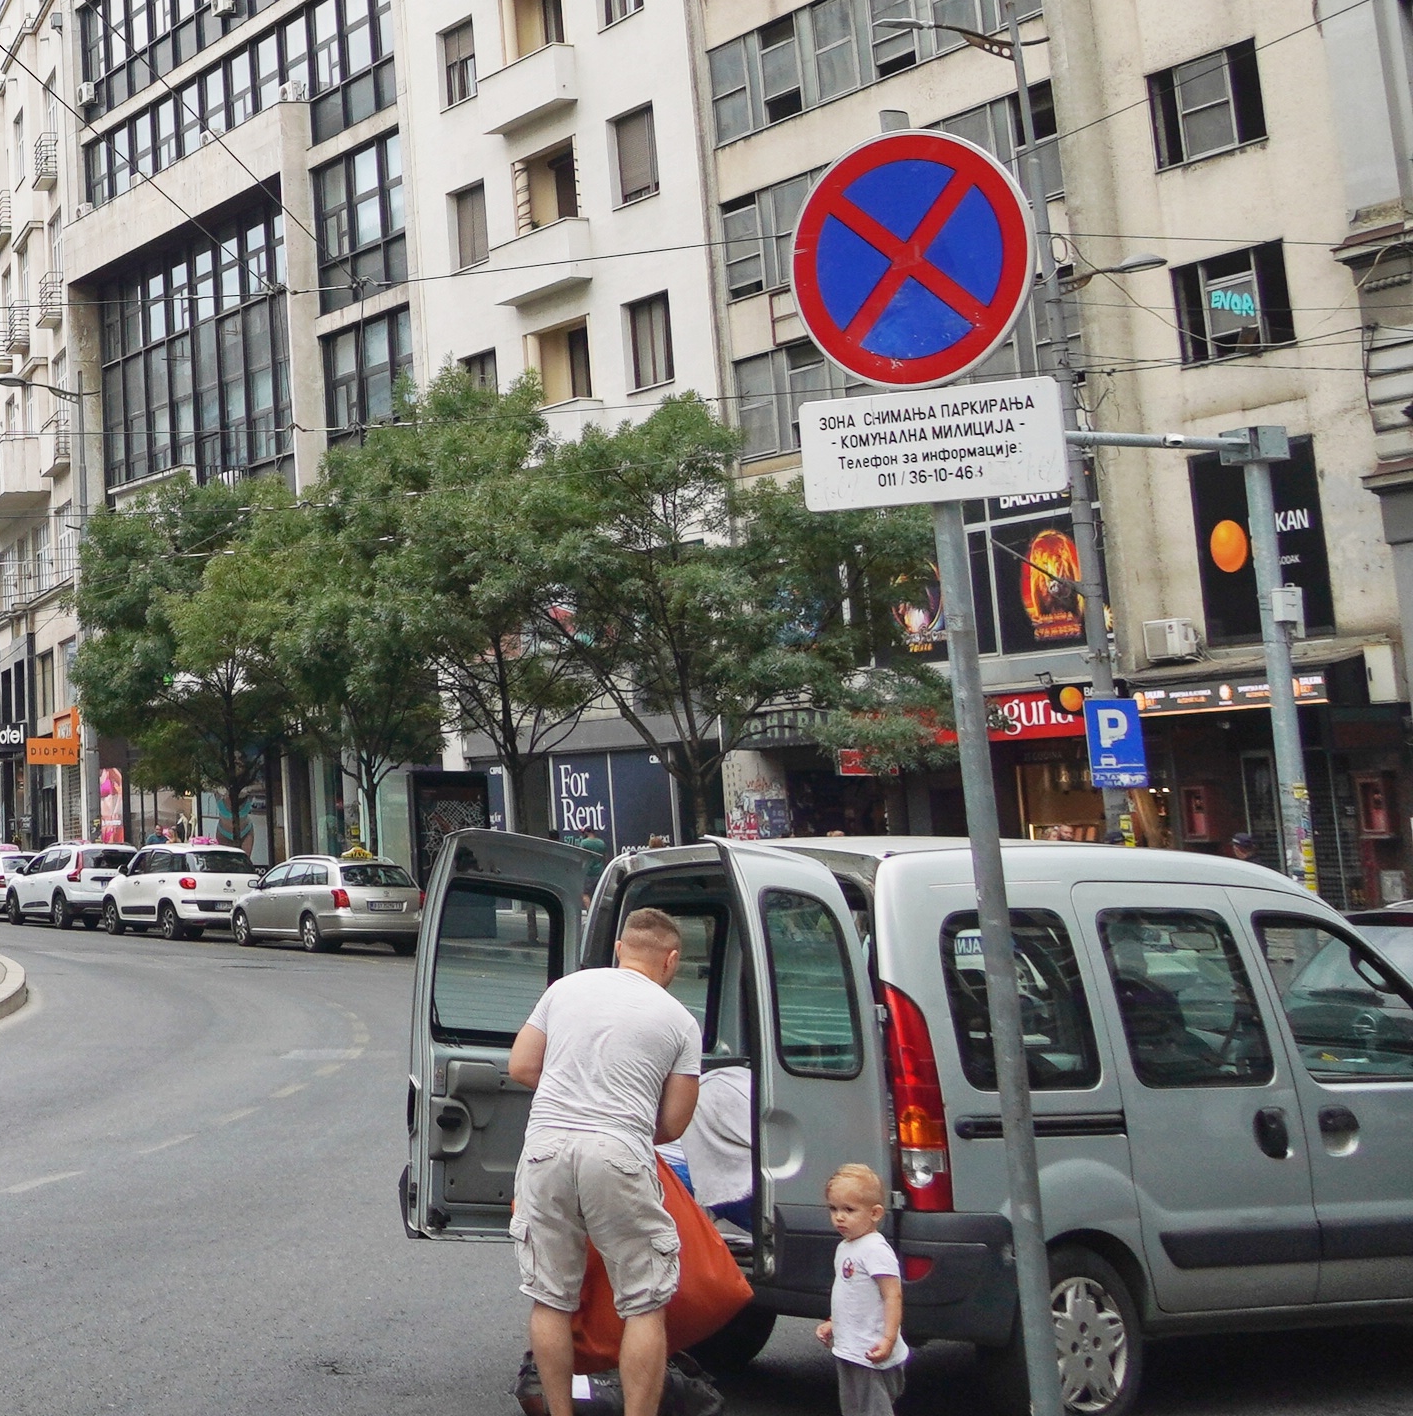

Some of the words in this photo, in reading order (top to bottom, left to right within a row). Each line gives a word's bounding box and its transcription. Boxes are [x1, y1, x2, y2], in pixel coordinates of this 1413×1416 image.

[819, 416, 856, 431] ЗОНА
[863, 405, 936, 426] СНИМАЊА
[940, 395, 1035, 419] ПАРКИРАЊА
[840, 426, 928, 449] КОМУНАЛНА
[931, 419, 1015, 441] МИЛИЦИЈА
[838, 453, 898, 471] Телефон
[902, 451, 919, 464] за
[1097, 709, 1128, 748] P
[30, 747, 74, 756] DIOPTA
[559, 765, 589, 798] For
[561, 798, 606, 832] Rent
